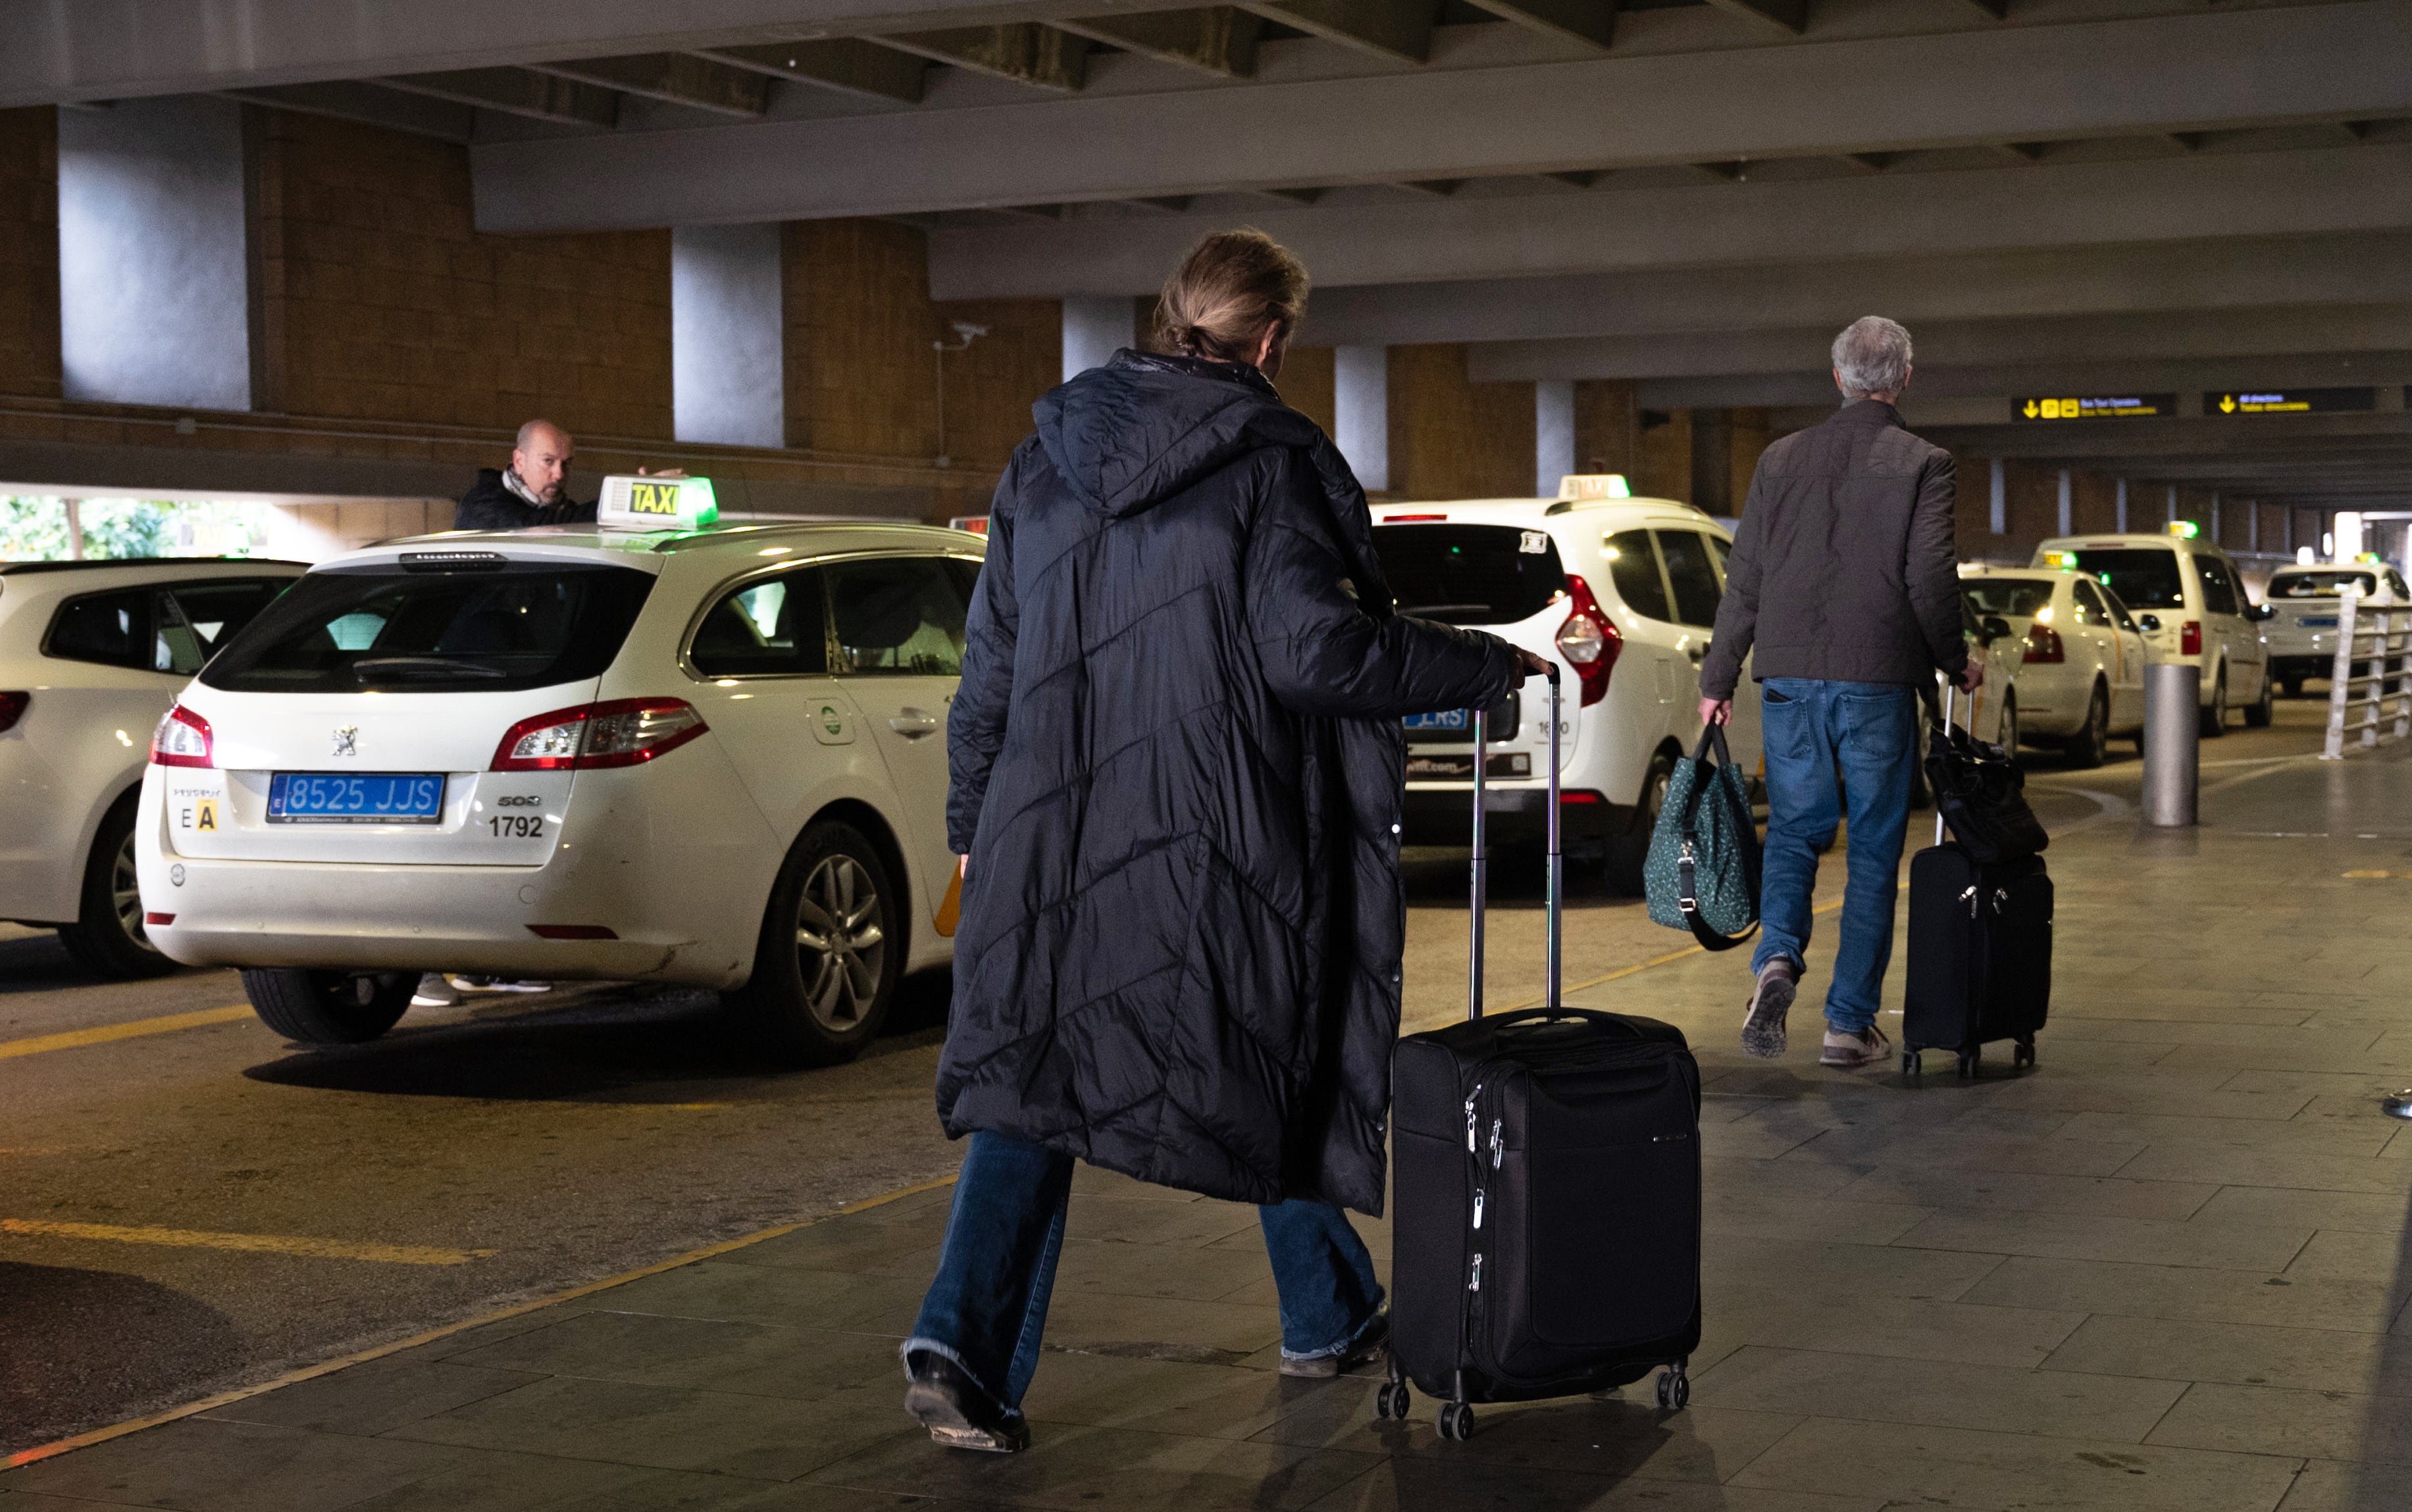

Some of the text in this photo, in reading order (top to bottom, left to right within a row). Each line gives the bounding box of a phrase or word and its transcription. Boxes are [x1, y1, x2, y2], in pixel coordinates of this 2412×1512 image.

[632, 483, 680, 514] TAXI
[1537, 721, 1569, 735] 160
[274, 798, 282, 809] E
[290, 779, 434, 811] 8525 JJS
[182, 806, 215, 829] E A
[489, 815, 543, 838] 1792
